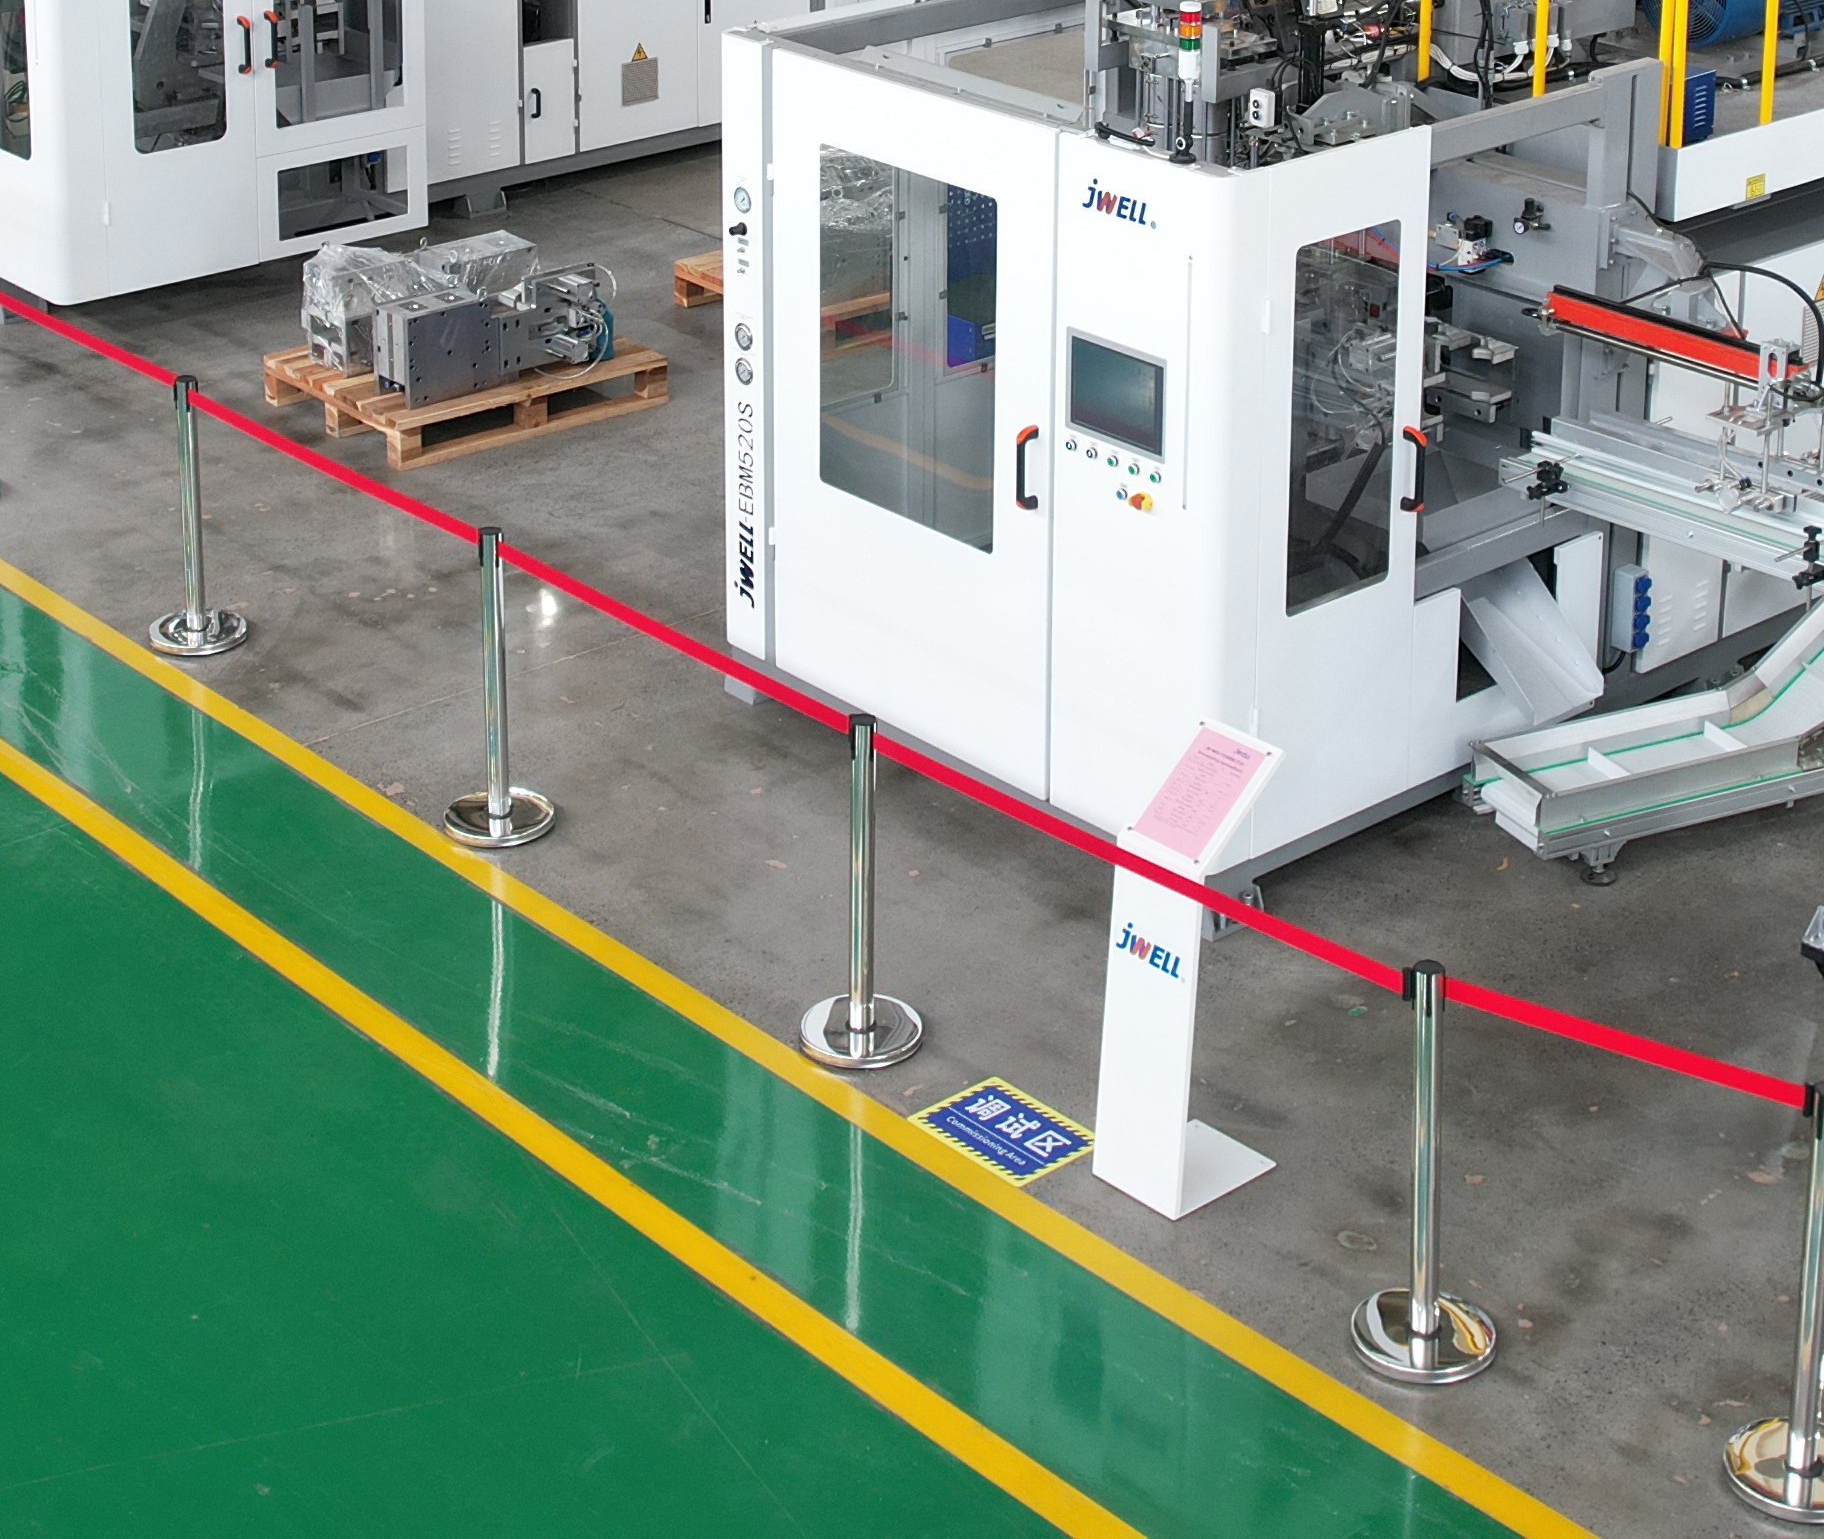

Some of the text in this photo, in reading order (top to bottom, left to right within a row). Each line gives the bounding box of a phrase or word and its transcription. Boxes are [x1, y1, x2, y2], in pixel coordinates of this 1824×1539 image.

[946, 1116, 1026, 1166] Commissioning Area
[964, 1094, 1072, 1158] 调试区
